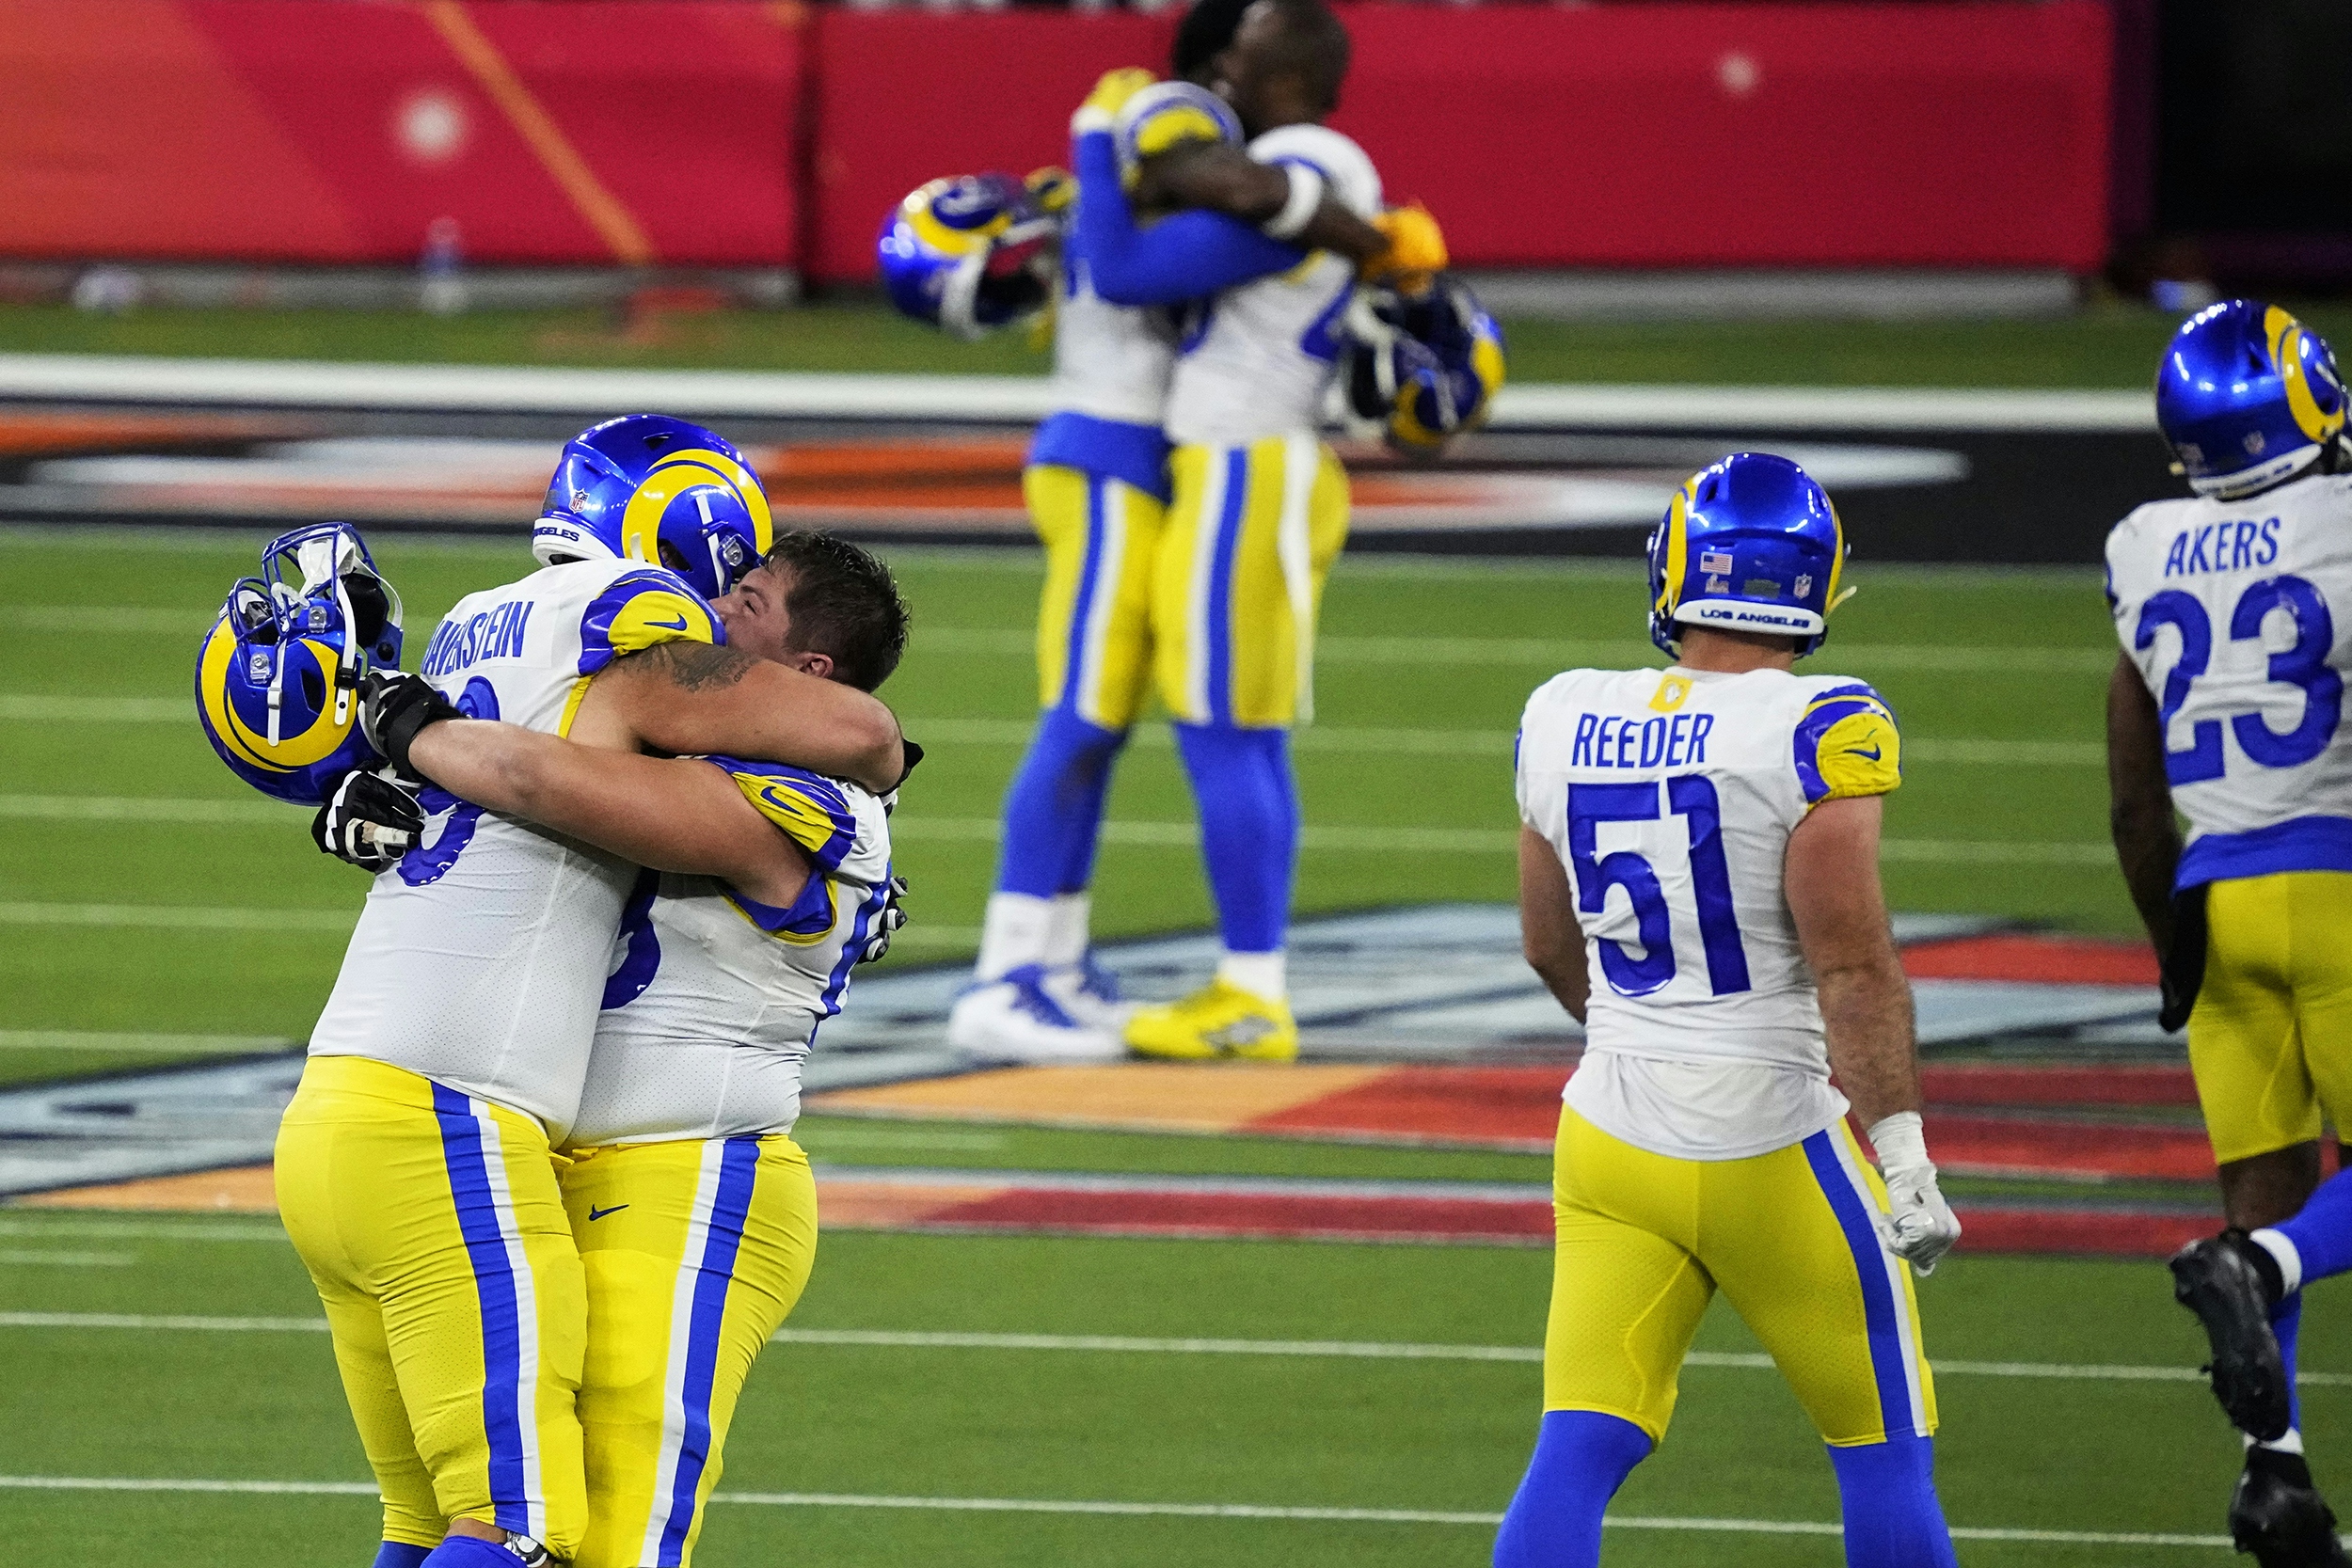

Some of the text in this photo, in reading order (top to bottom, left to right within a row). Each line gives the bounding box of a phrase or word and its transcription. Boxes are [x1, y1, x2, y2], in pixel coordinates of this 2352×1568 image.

[2166, 516, 2280, 578] AKERS
[1700, 610, 1811, 629] LOS ANGELES
[2135, 574, 2344, 787] 23
[1572, 713, 1714, 768] REEDER
[1567, 773, 1751, 998] 51
